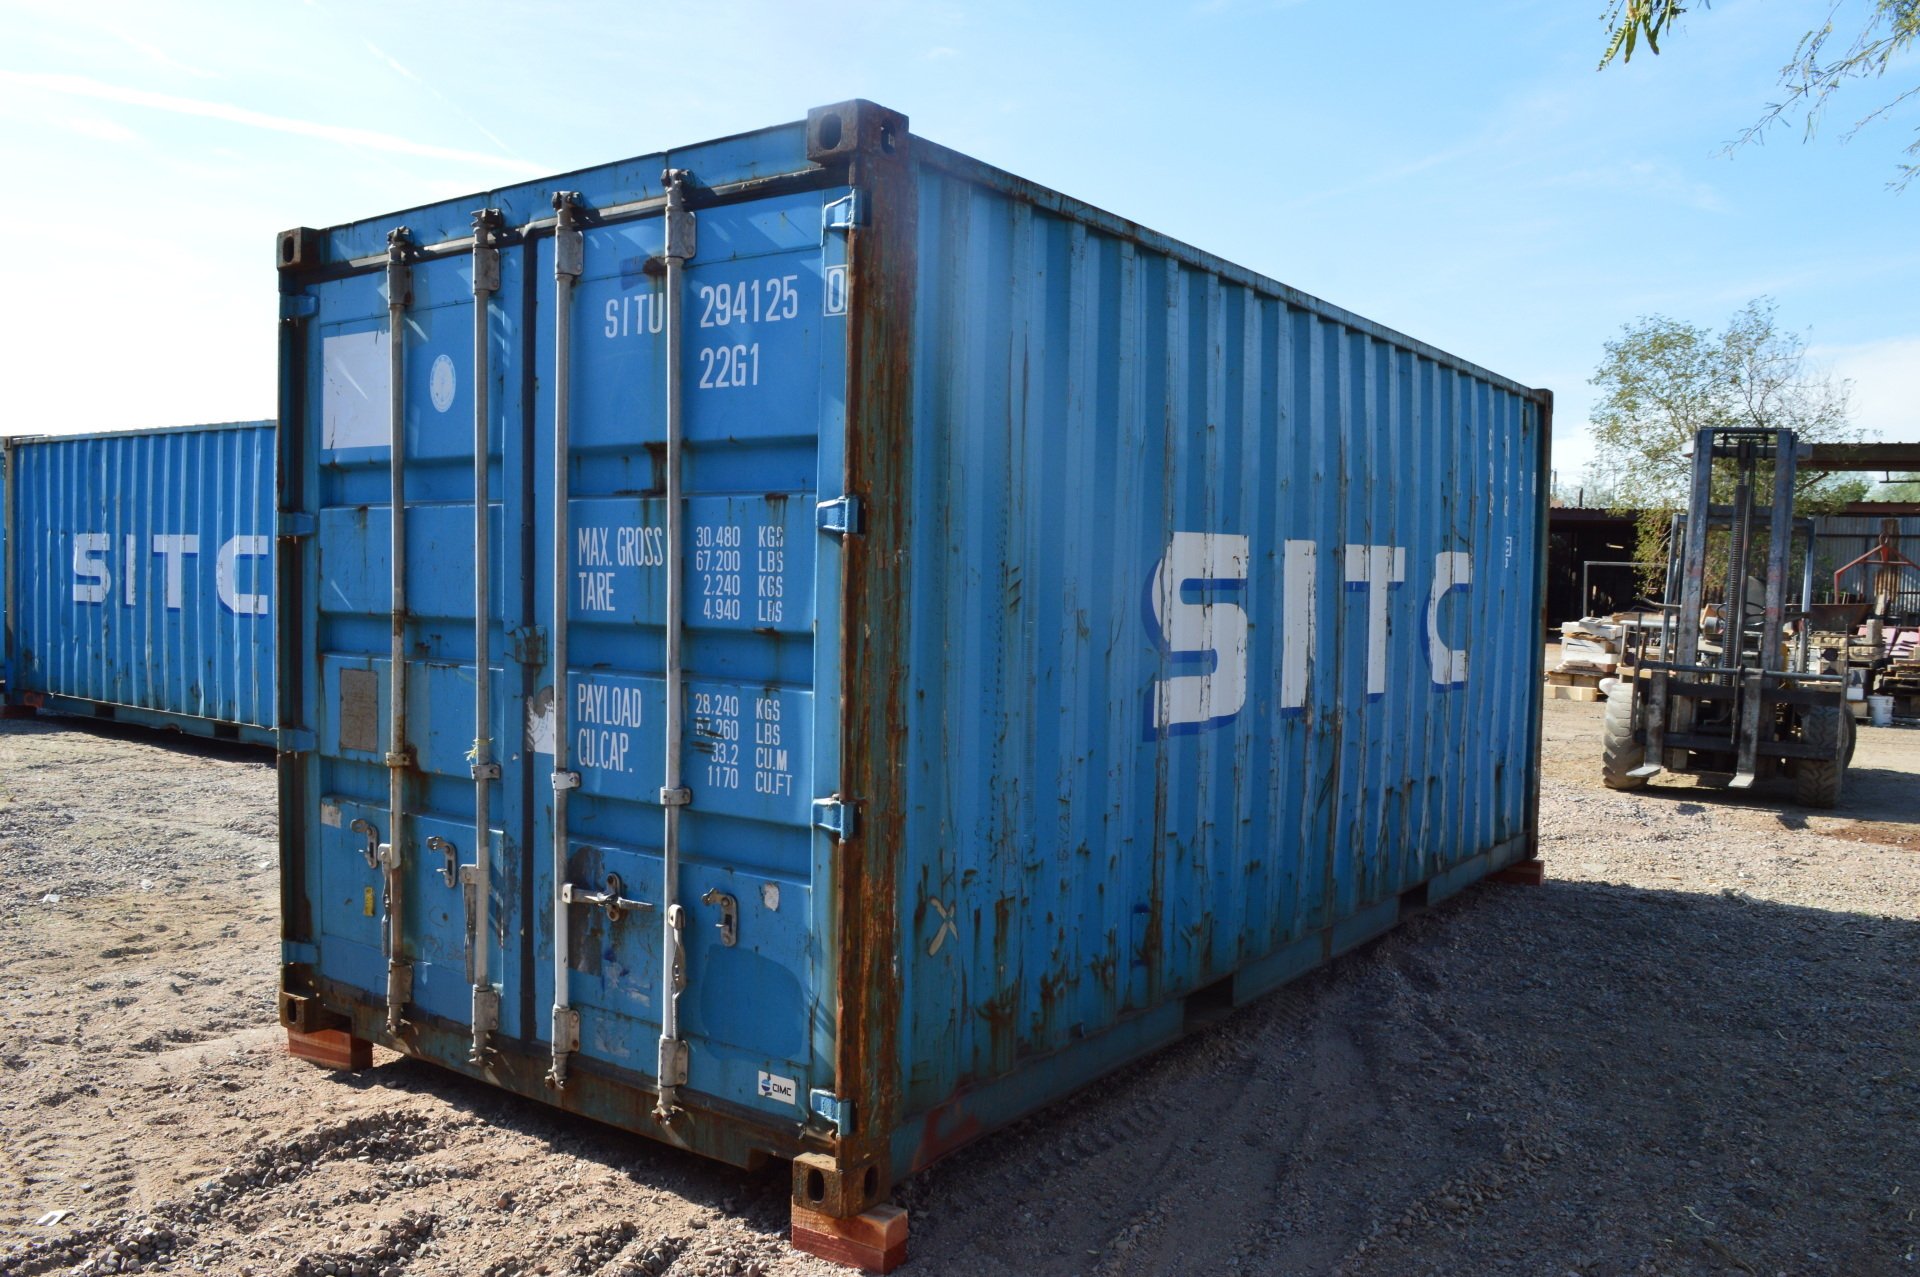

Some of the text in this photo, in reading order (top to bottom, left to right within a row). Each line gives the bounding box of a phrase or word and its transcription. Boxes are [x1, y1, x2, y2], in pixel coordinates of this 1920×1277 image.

[605, 292, 664, 339] SITU
[700, 274, 798, 329] 294125
[700, 342, 759, 389] 22G1
[578, 526, 664, 567] MAX. GROSS
[758, 525, 784, 548] KGS
[72, 532, 269, 616] SITC
[758, 550, 784, 573] LBS
[578, 572, 616, 611] TARE
[758, 575, 783, 598] KGS
[758, 600, 783, 623] LBS
[1143, 531, 1473, 740] SITC
[577, 683, 642, 728] PAYLOAD
[756, 698, 780, 721] KGS
[756, 722, 780, 746] LBS
[711, 742, 788, 772] 33.2 CU.M
[708, 765, 793, 796] 1170 CU.FT
[772, 1083, 792, 1097] CIMC
